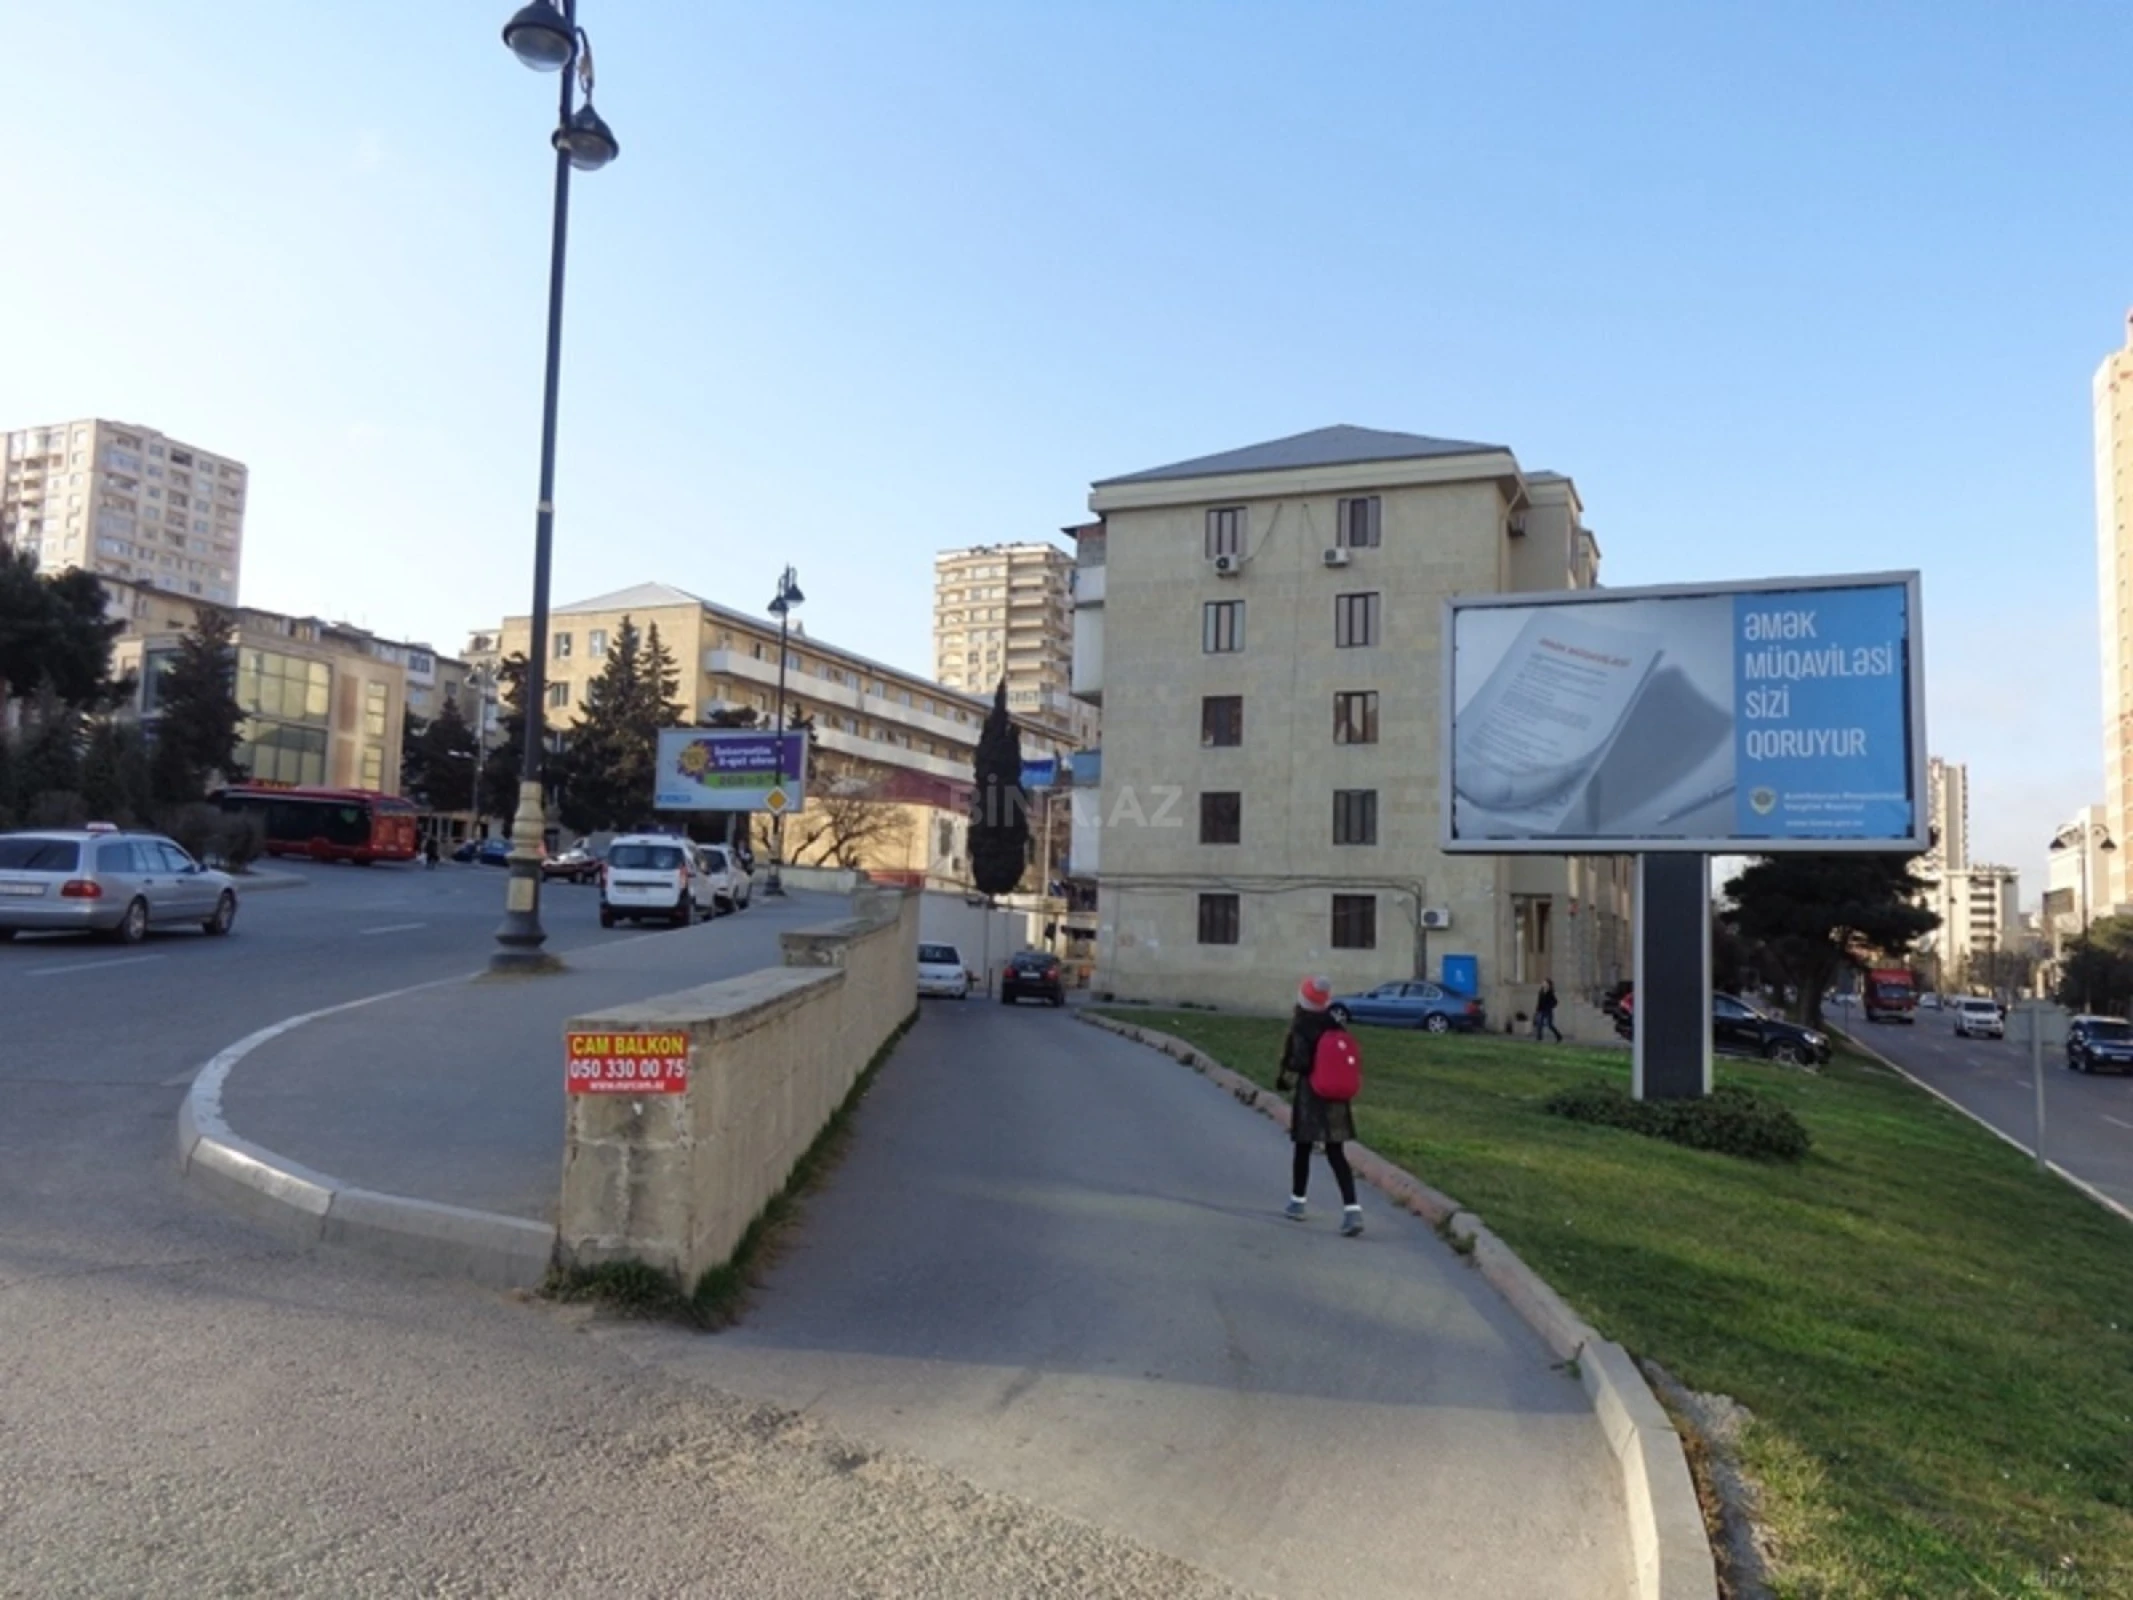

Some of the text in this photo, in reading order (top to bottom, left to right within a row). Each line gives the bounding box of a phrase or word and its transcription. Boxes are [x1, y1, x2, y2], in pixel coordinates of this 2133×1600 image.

[1744, 610, 1818, 641] ƏMƏK
[1745, 641, 1892, 681] MÜQAVİLƏSİ
[1745, 684, 1790, 719] SİZİ
[1746, 727, 1867, 761] QORUYUR
[572, 1036, 684, 1055] CAM BALKON
[570, 1058, 685, 1078] 050 330 00 75
